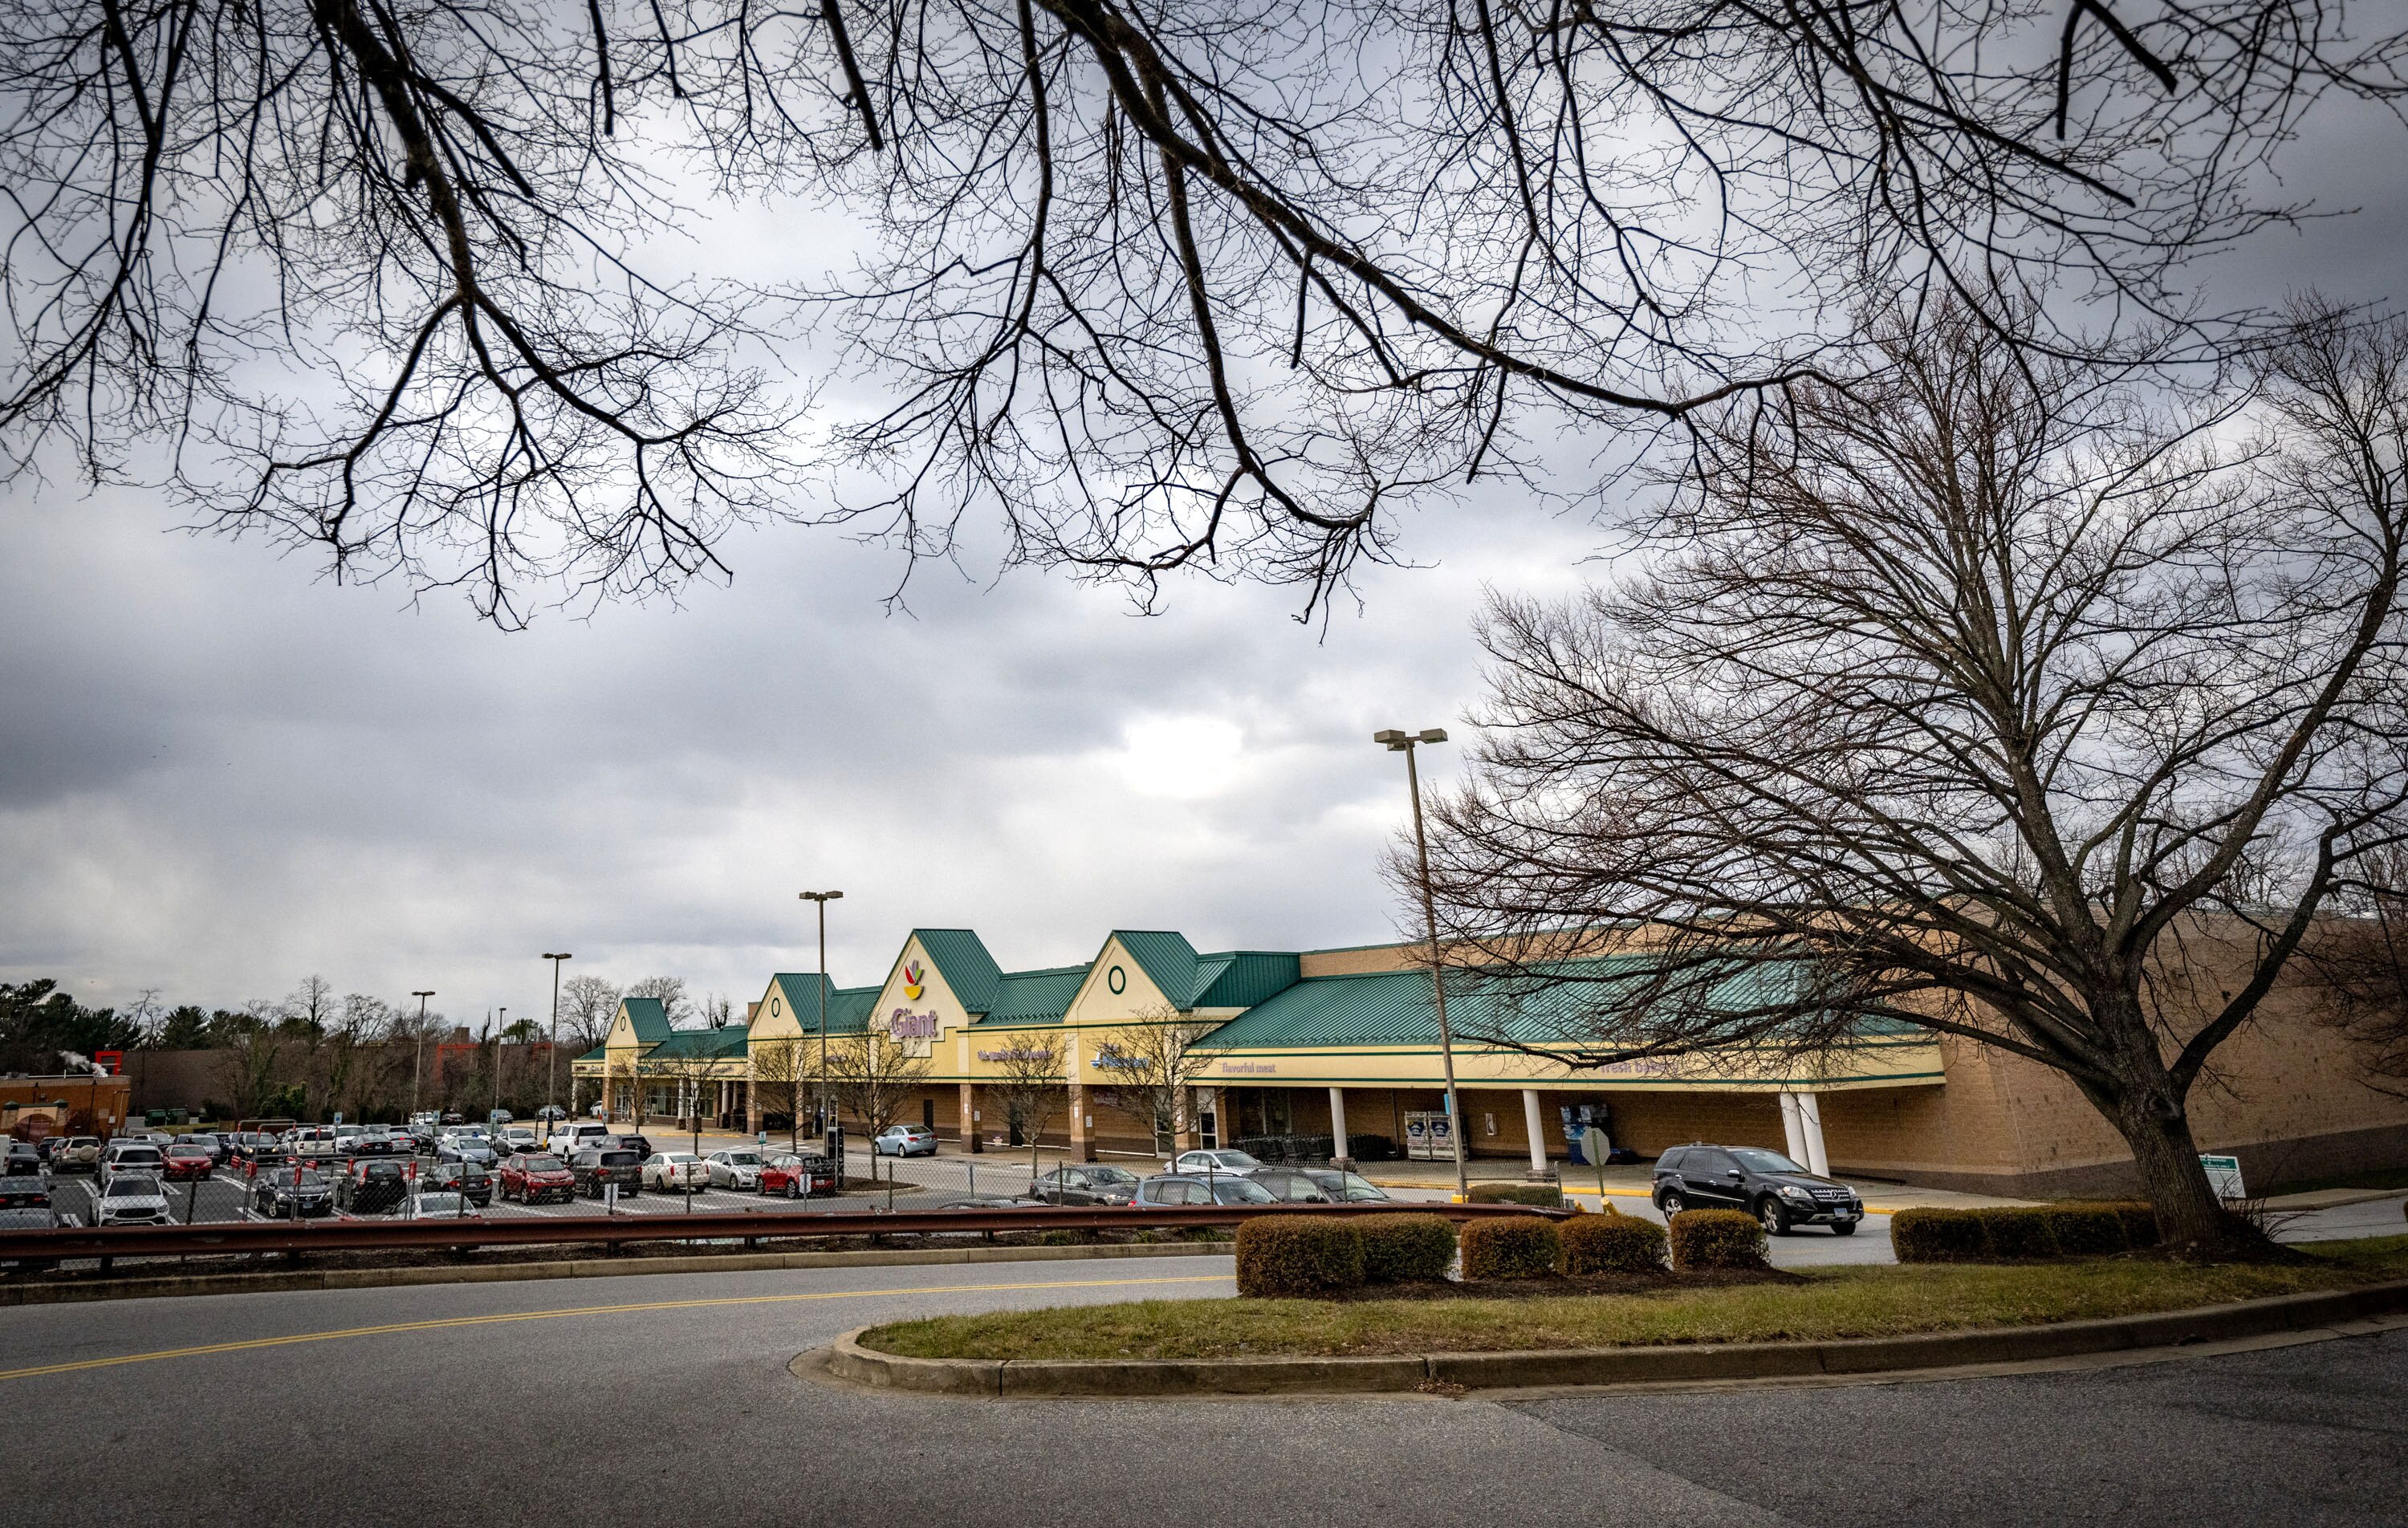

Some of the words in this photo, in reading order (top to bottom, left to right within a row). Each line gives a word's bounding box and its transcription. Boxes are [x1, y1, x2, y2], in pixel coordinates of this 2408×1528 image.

[892, 1008, 938, 1038] Giant
[1222, 1062, 1255, 1073] flavorful
[1256, 1064, 1276, 1073] meat
